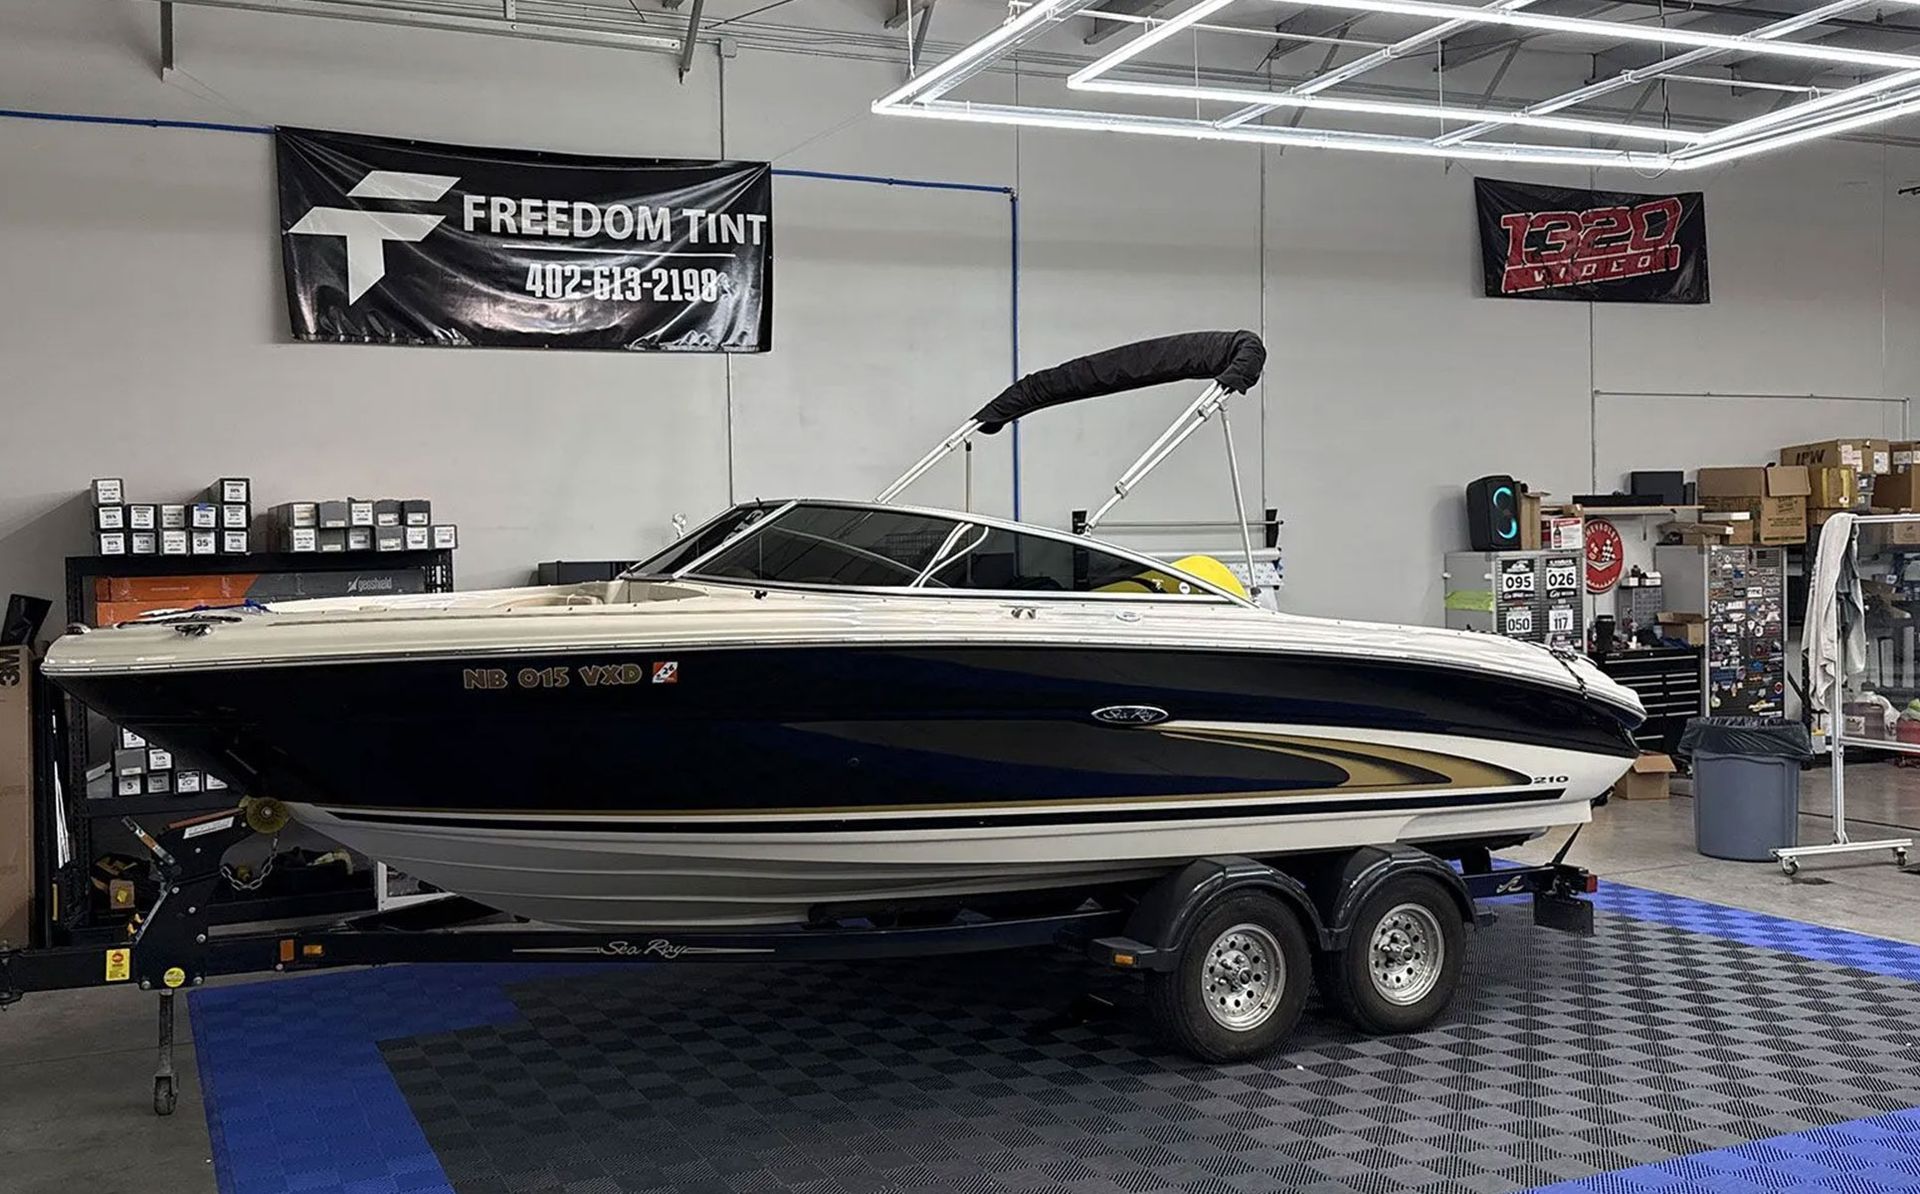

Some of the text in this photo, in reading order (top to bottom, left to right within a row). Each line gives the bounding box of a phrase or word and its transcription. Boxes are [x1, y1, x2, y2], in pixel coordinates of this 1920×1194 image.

[463, 195, 768, 246] FREEDOM TINT
[1501, 197, 1683, 268] 1320
[525, 262, 719, 302] 402-613-2198
[1586, 523, 1620, 543] HEVROLET
[1505, 575, 1532, 589] 095
[1548, 572, 1575, 587] 026
[1507, 617, 1531, 632] 050
[463, 663, 643, 690] NB 015 VXD
[1533, 775, 1569, 785] 210
[600, 938, 689, 959] Sea Ray
